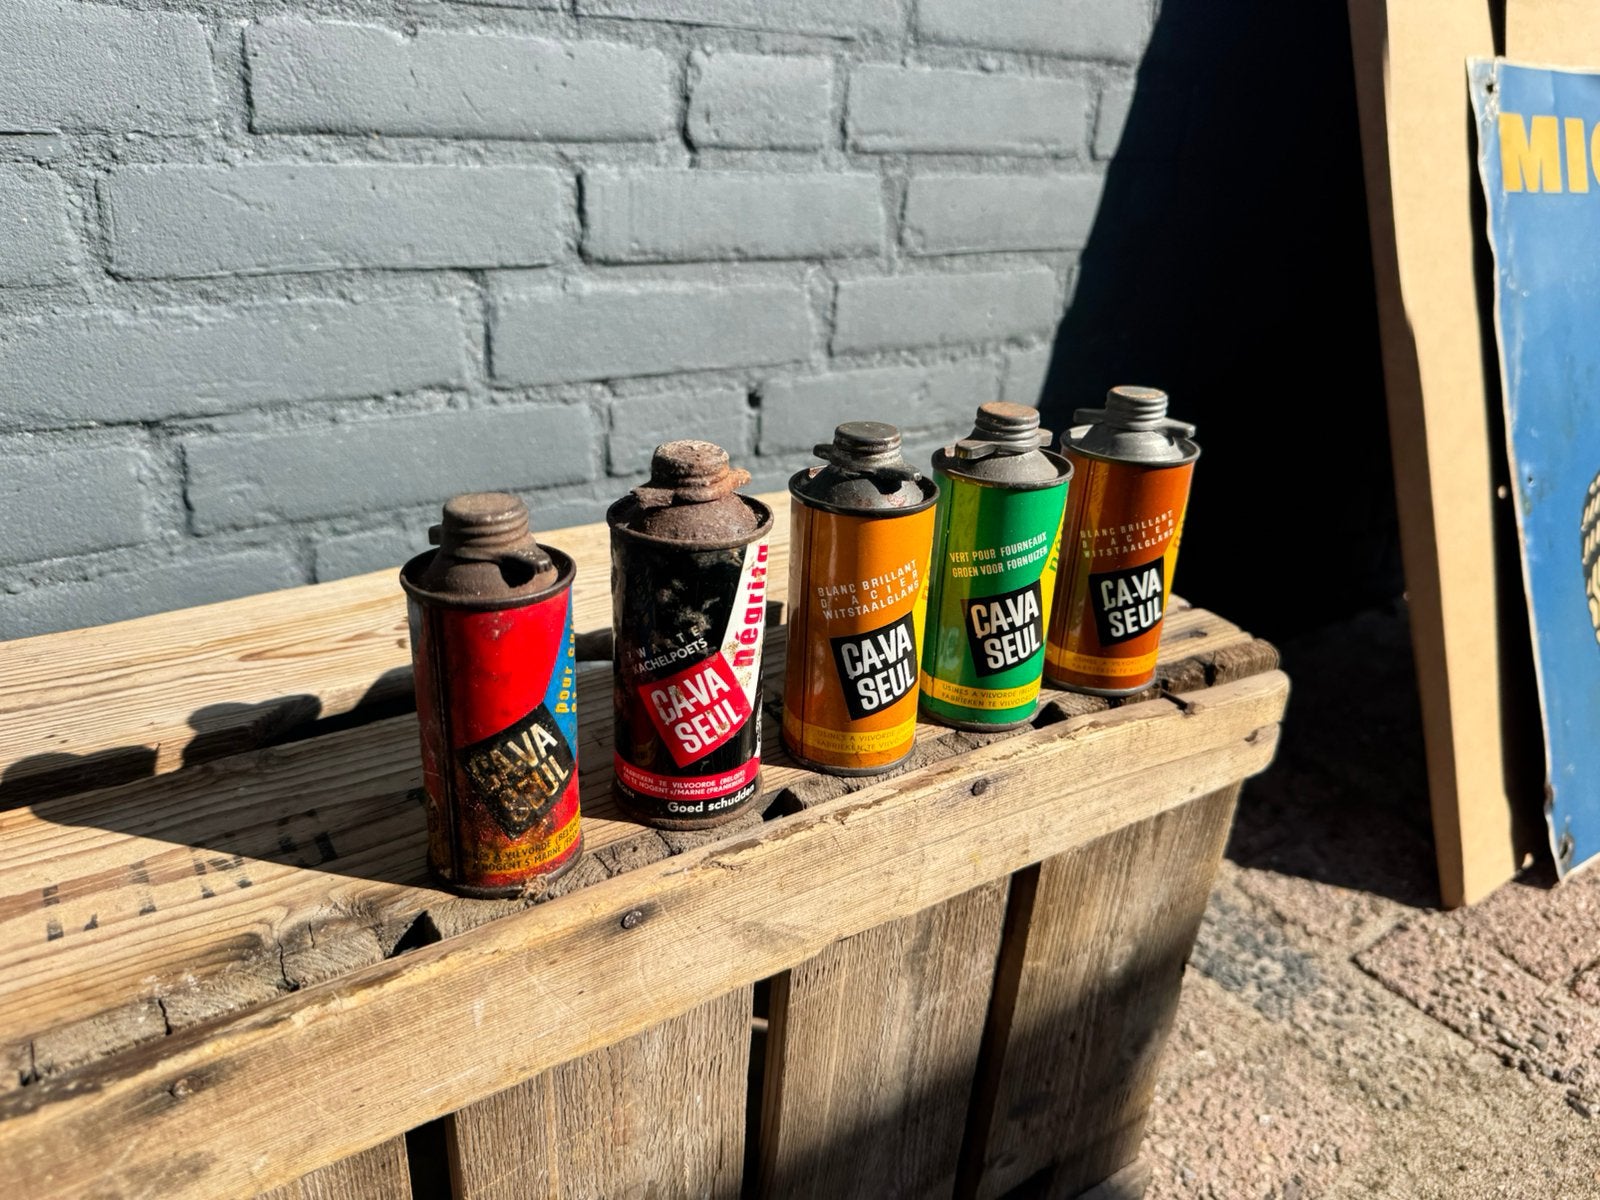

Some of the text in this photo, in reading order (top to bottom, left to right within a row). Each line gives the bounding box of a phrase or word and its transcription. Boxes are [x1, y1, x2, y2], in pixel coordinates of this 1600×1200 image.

[1498, 112, 1600, 193] MI
[1080, 509, 1173, 538] BLANC BRILLANT
[949, 531, 1047, 563] VERT POUR FOURNEAUX
[952, 545, 1048, 578] GROEN VOOR FORNUIZEN
[817, 559, 917, 597] BLANC BRILLANT
[732, 544, 769, 667] négrita
[822, 580, 919, 620] WITSTAALGLANS
[1108, 596, 1162, 638] SEUL
[632, 637, 708, 675] KACHELPOETS
[983, 623, 1041, 670] SEUL
[856, 658, 915, 711] SEUL
[674, 699, 743, 754] SEUL
[667, 784, 755, 813] Goed schudden
[672, 780, 716, 790] VILVOORDE
